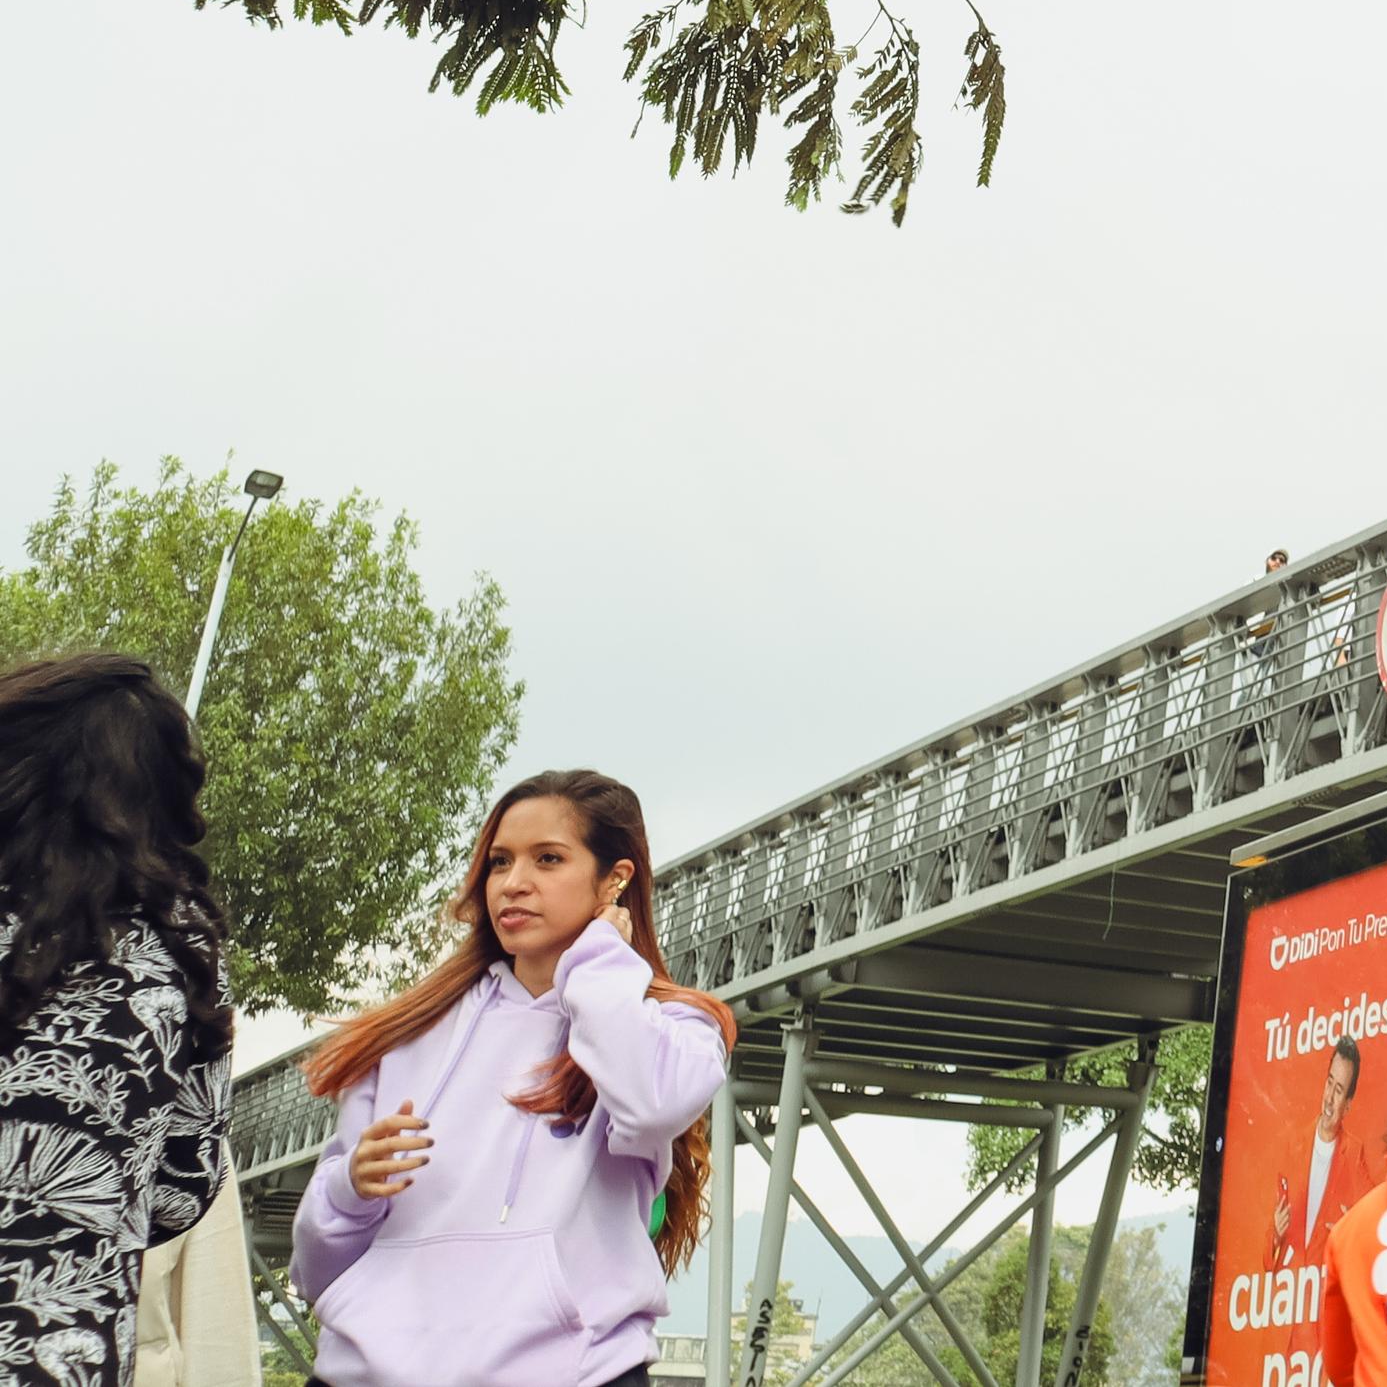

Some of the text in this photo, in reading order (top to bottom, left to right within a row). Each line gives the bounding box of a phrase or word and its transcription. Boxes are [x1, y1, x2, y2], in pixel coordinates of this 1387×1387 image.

[1289, 929, 1319, 964] DiDi
[1319, 927, 1345, 955] Pon
[1348, 918, 1363, 946] Tu
[1265, 1012, 1291, 1063] Tú
[1229, 1245, 1327, 1332] cuán
